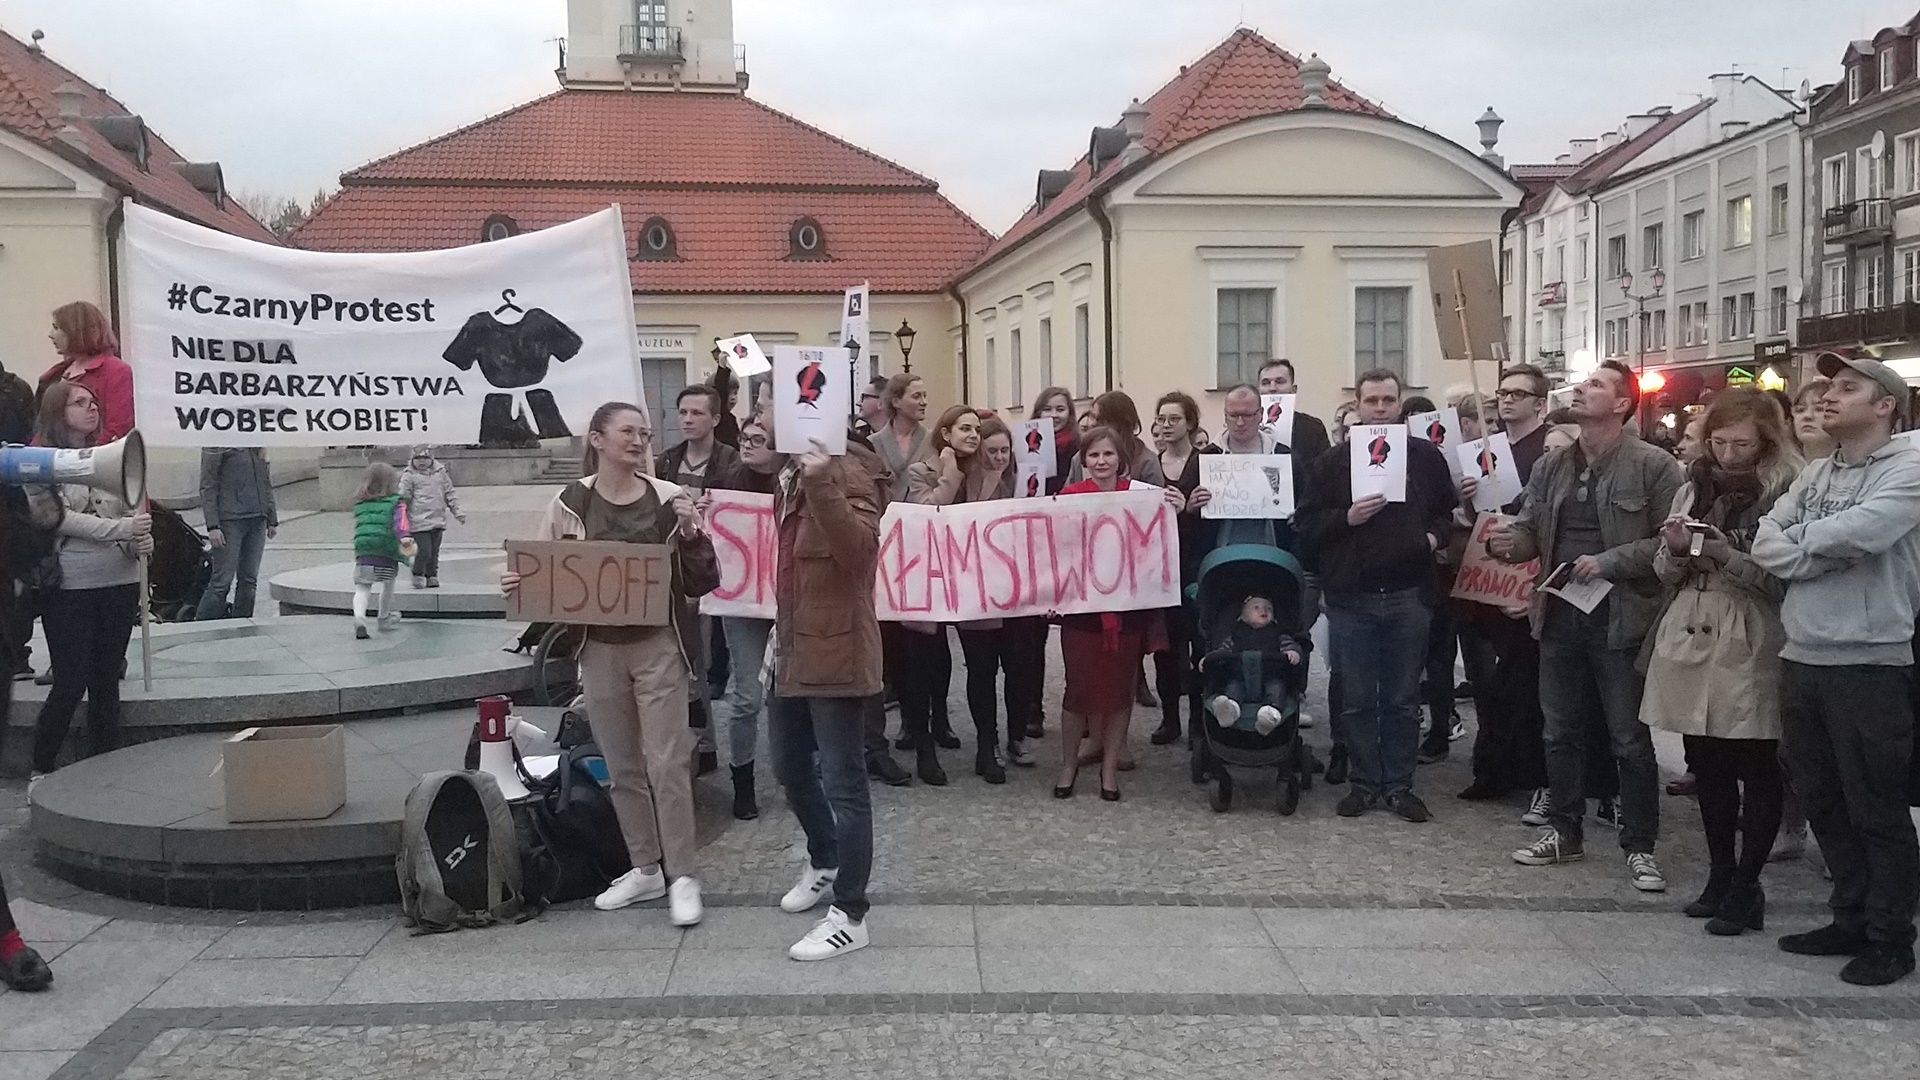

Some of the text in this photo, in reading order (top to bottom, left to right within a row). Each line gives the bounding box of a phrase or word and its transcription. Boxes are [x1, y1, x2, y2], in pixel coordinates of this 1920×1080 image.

[168, 282, 436, 326] #CzarnyProtest
[171, 335, 298, 365] NIE DLA
[175, 371, 465, 398] BARBARZYŃSTWA
[174, 406, 428, 432] WOBEC KOBIET!
[1369, 427, 1388, 436] 16/10
[1458, 564, 1518, 599] PRAWO
